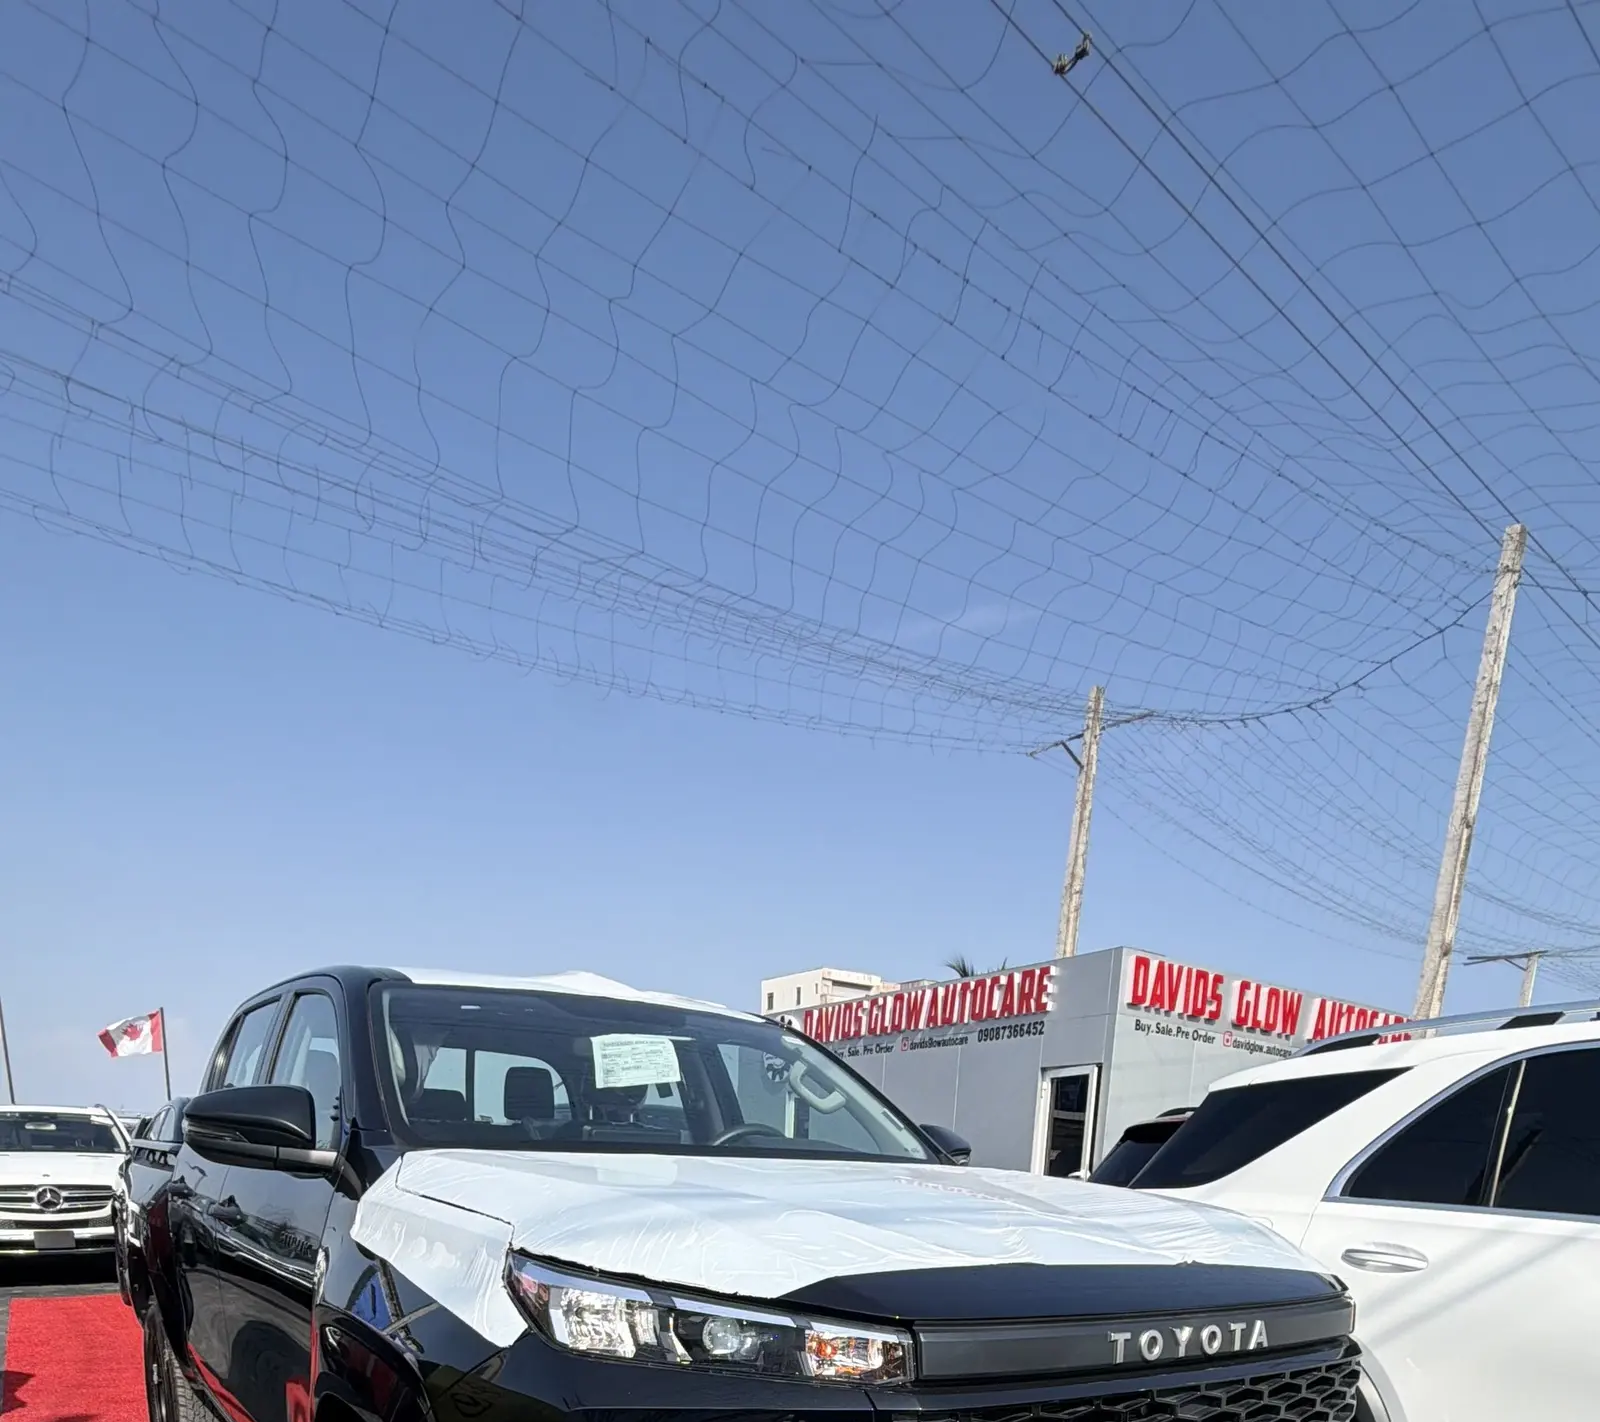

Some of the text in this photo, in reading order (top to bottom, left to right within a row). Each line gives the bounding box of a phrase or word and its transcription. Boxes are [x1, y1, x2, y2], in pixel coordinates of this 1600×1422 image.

[803, 966, 1053, 1043] DAVIDS GLOW AUTOCARE
[1130, 955, 1225, 1021] DAVIDS
[1234, 980, 1303, 1036] GLOW
[977, 1020, 1045, 1043] 09087366452
[1191, 1029, 1216, 1045] Order
[875, 1043, 894, 1054] Order
[1108, 1320, 1269, 1364] TOYOTA
